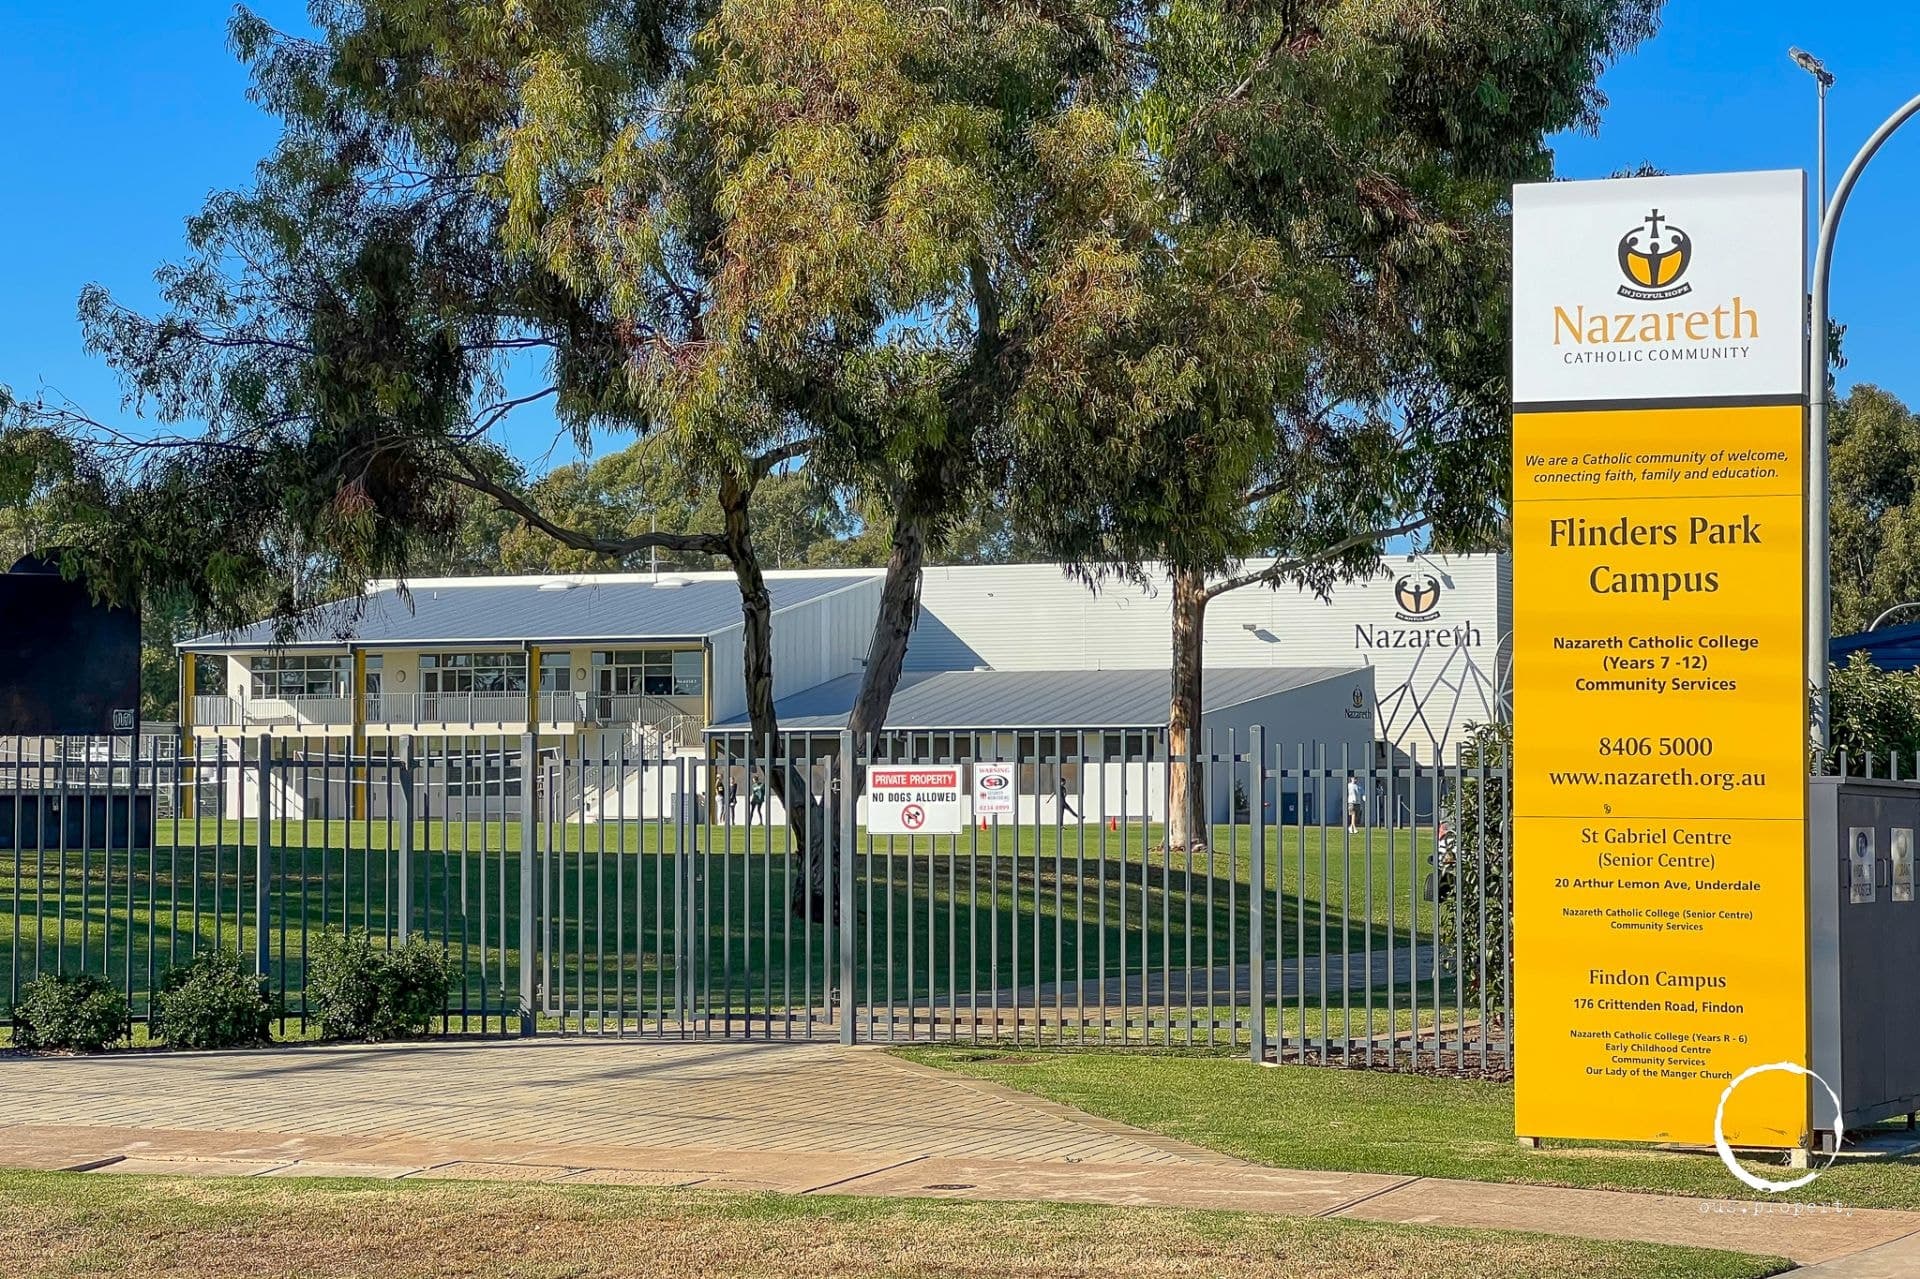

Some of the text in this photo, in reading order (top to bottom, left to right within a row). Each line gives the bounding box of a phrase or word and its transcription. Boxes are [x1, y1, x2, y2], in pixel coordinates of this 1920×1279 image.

[1630, 290, 1664, 299] JOYFUL
[1664, 285, 1689, 297] HOPE
[1553, 297, 1758, 345] Nazareth
[1564, 346, 1749, 365] CATHOLIC COMMUNITY
[1526, 449, 1788, 467] We are a Catholic community of welcome,
[1534, 466, 1778, 484] connecting faith, family and education.
[1550, 514, 1762, 546] Flinders Park
[1590, 566, 1718, 600] Campus
[1355, 620, 1481, 649] Nazareth
[1554, 636, 1758, 650] Nazareth Catholic College
[1603, 656, 1654, 671] (Years
[1661, 657, 1669, 668] 7
[1576, 678, 1736, 693] Community Services
[1599, 737, 1712, 756] 8406 5000
[875, 774, 953, 784] PRIVATE PROPERTY
[1549, 769, 1766, 790] www.nazareth.org.au
[872, 792, 957, 802] NO DOGS ALLOWED
[1582, 828, 1732, 846] St Gabriel Centre
[1598, 853, 1715, 870] (Senior Centre)
[1555, 878, 1760, 891] 20 Arthur Lemon Ave, Underdale
[1562, 908, 1752, 920] Nazareth Catholic College (Senior Centre)
[1611, 921, 1703, 932] Community Services
[1590, 970, 1726, 991] Findon Campus
[1574, 999, 1743, 1014] 176 Crittenden Road, Findon
[1570, 1030, 1611, 1039] Nazareth
[1614, 1031, 1652, 1041] Catholic
[1654, 1032, 1690, 1043] College
[1692, 1033, 1721, 1043] (Years
[1724, 1034, 1730, 1042] R
[1739, 1034, 1748, 1044] 6)
[1606, 1043, 1711, 1054] Early Childhood Centre
[1612, 1056, 1706, 1066] Community Services
[1586, 1067, 1732, 1080] Our Lady of the Manger Church
